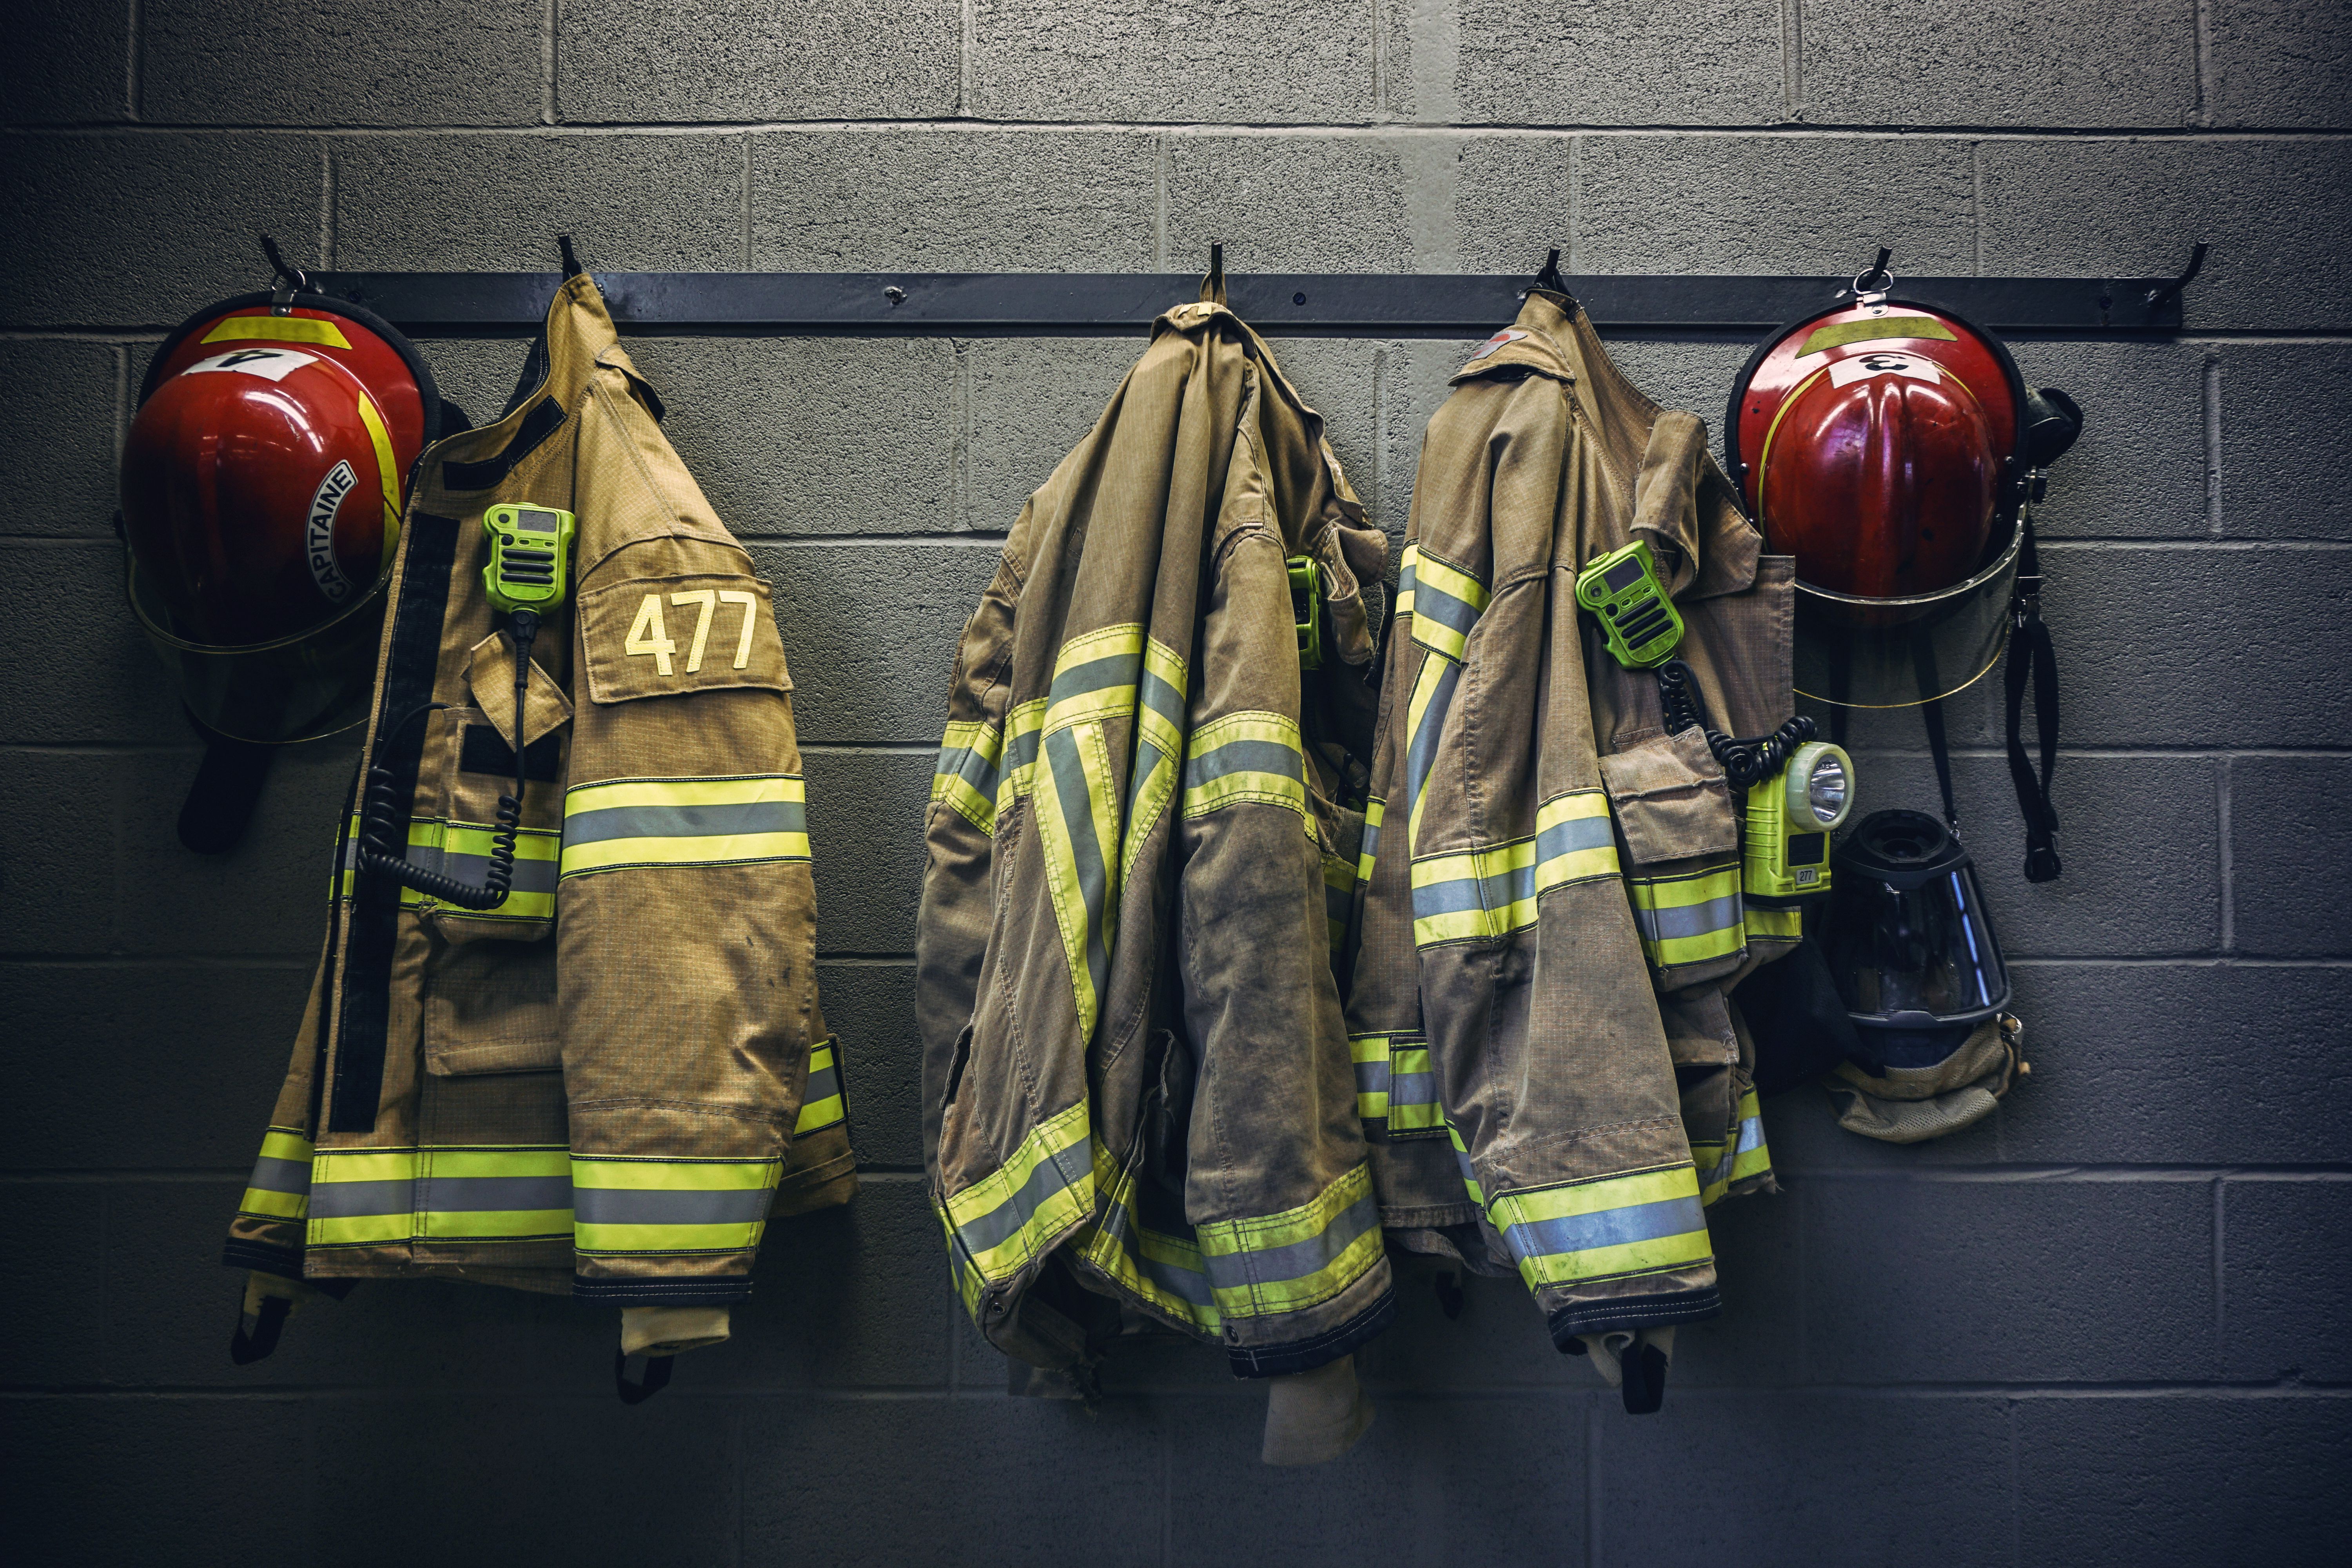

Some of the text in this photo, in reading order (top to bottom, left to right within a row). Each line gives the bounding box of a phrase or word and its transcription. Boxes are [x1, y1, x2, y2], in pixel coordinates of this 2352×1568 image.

[311, 468, 352, 598] CAPITAINE
[624, 589, 757, 676] 477
[1800, 871, 1812, 881] 277
